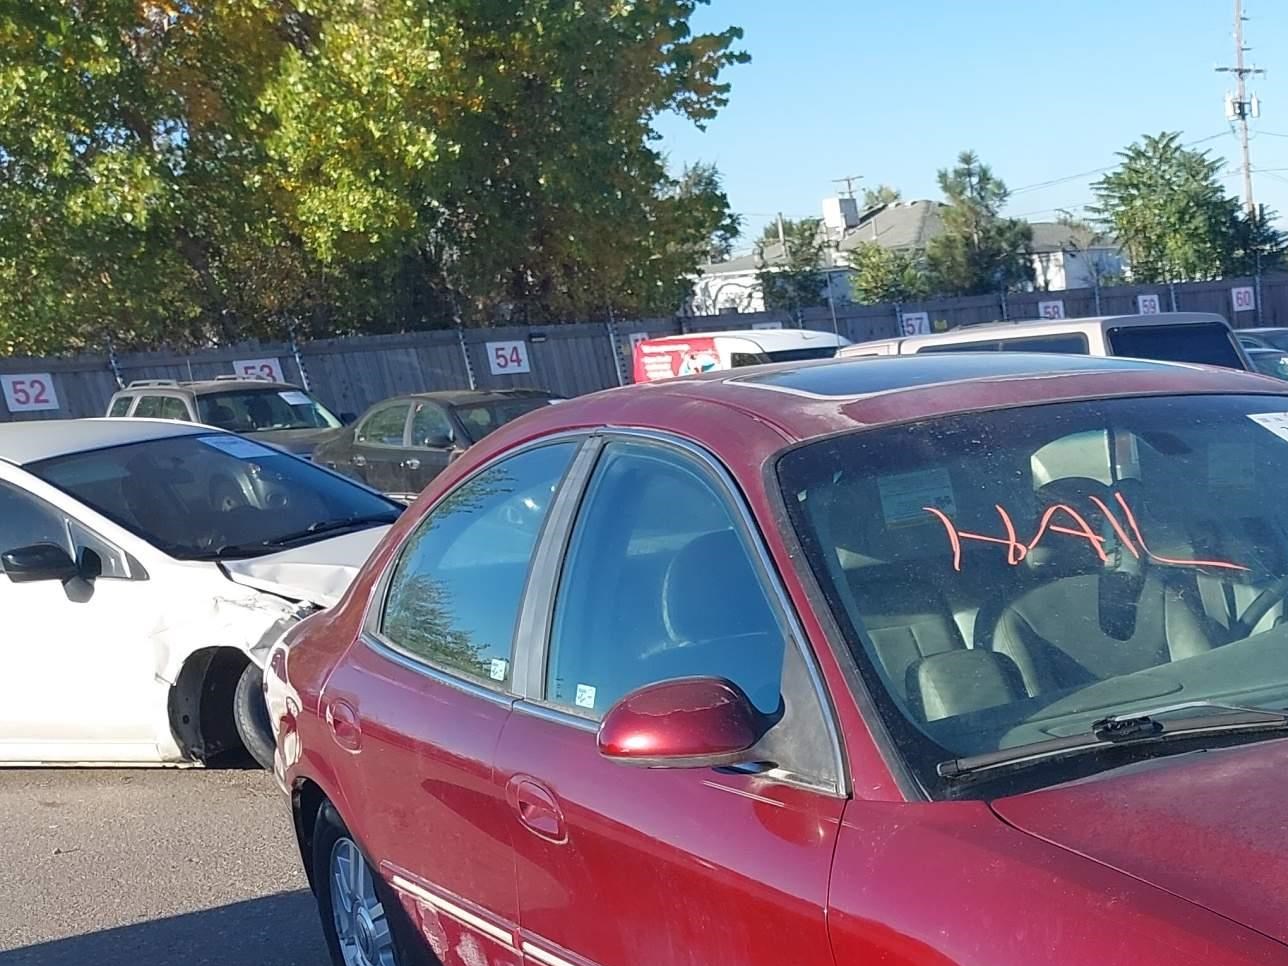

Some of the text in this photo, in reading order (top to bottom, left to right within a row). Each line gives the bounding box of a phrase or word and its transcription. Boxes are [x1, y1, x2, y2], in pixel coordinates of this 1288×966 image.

[1236, 290, 1251, 307] 60
[1044, 305, 1061, 320] 58
[905, 317, 924, 336] 57
[495, 345, 522, 369] 54
[12, 379, 49, 405] 52
[922, 492, 1252, 572] HAIL
